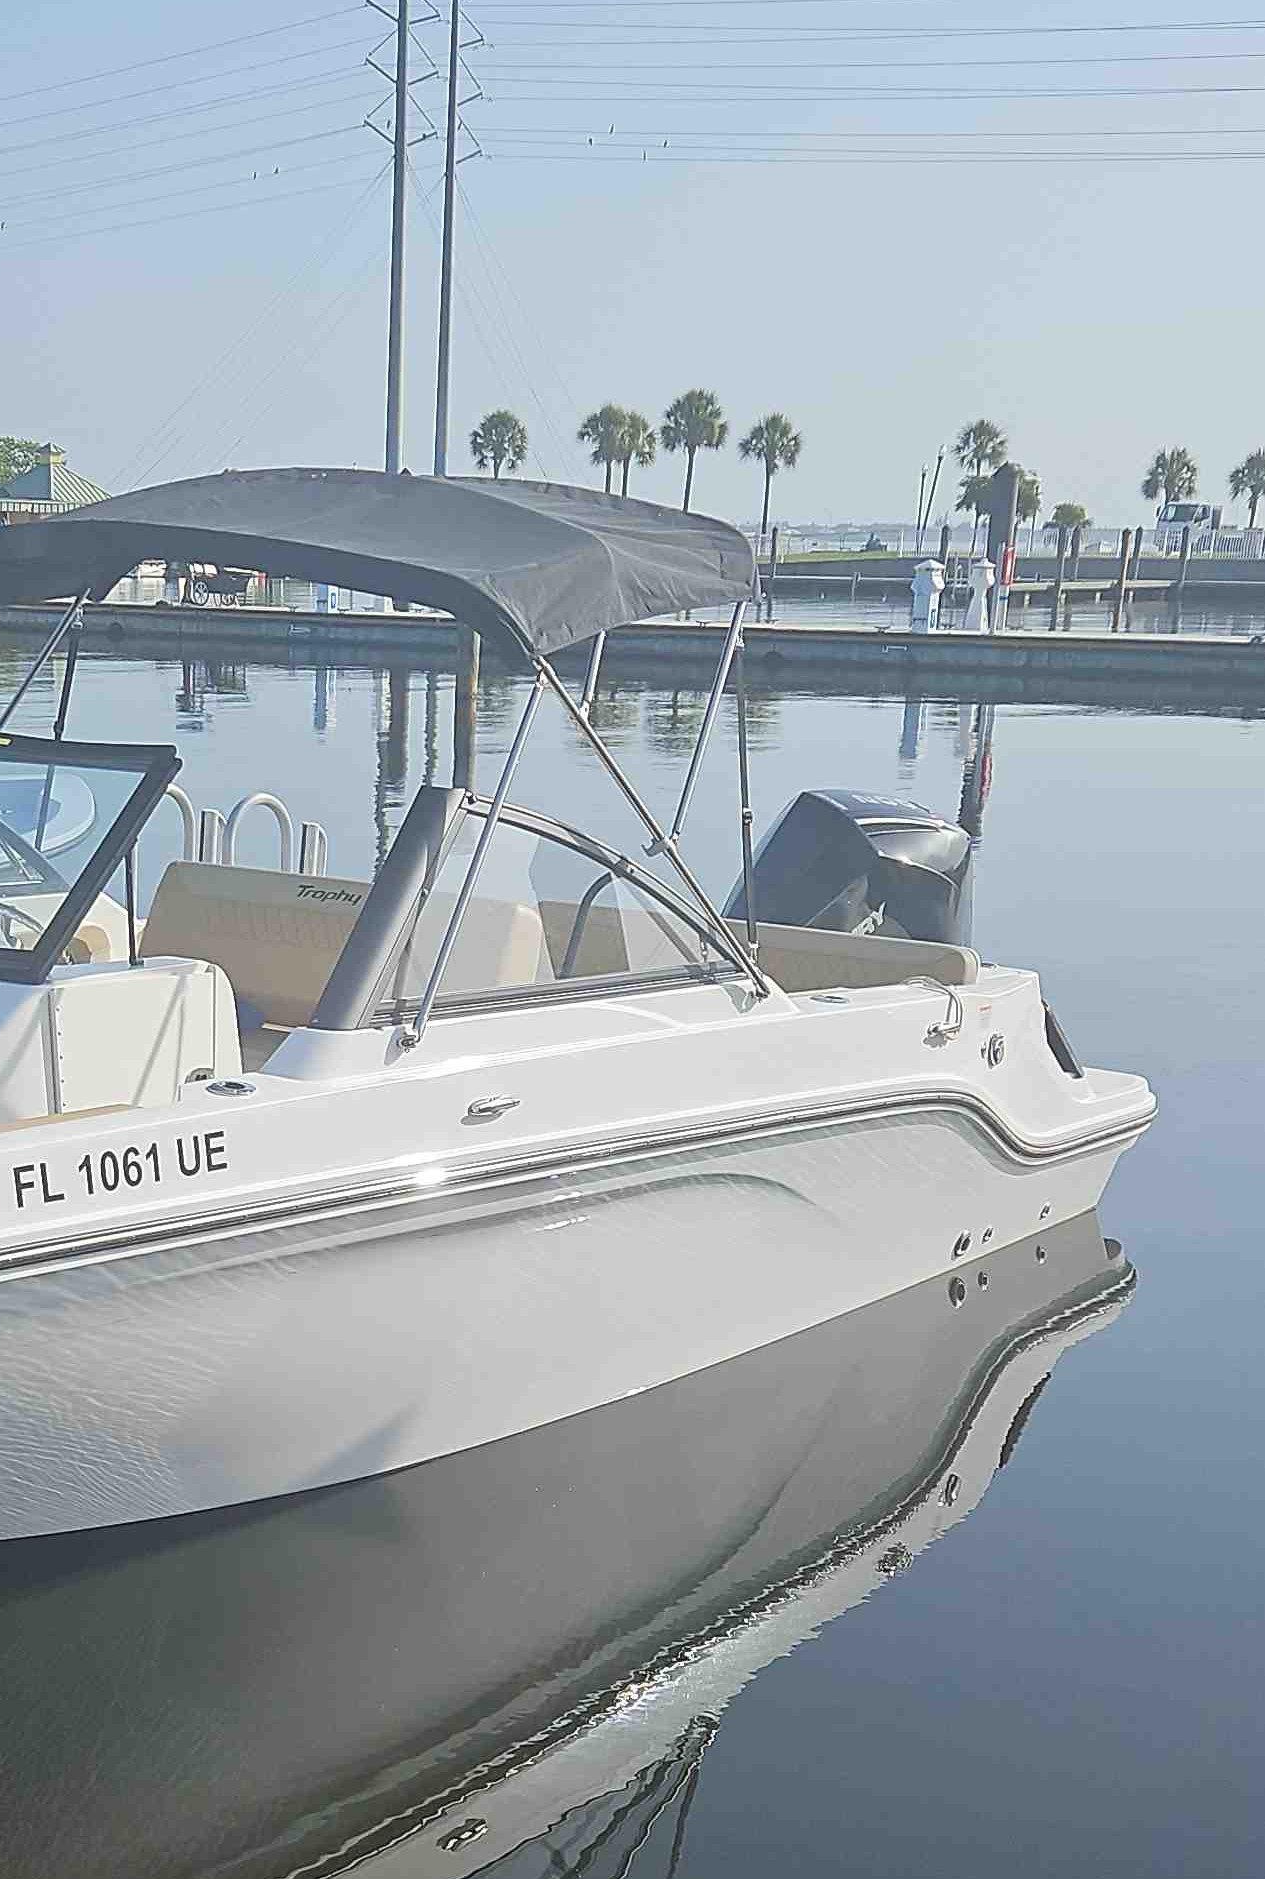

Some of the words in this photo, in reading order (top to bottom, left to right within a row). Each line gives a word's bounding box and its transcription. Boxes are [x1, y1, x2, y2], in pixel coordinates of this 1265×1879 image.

[297, 884, 362, 906] Trophy
[12, 1162, 66, 1209] FL
[77, 1142, 162, 1195] 1061
[176, 1130, 229, 1177] UE
